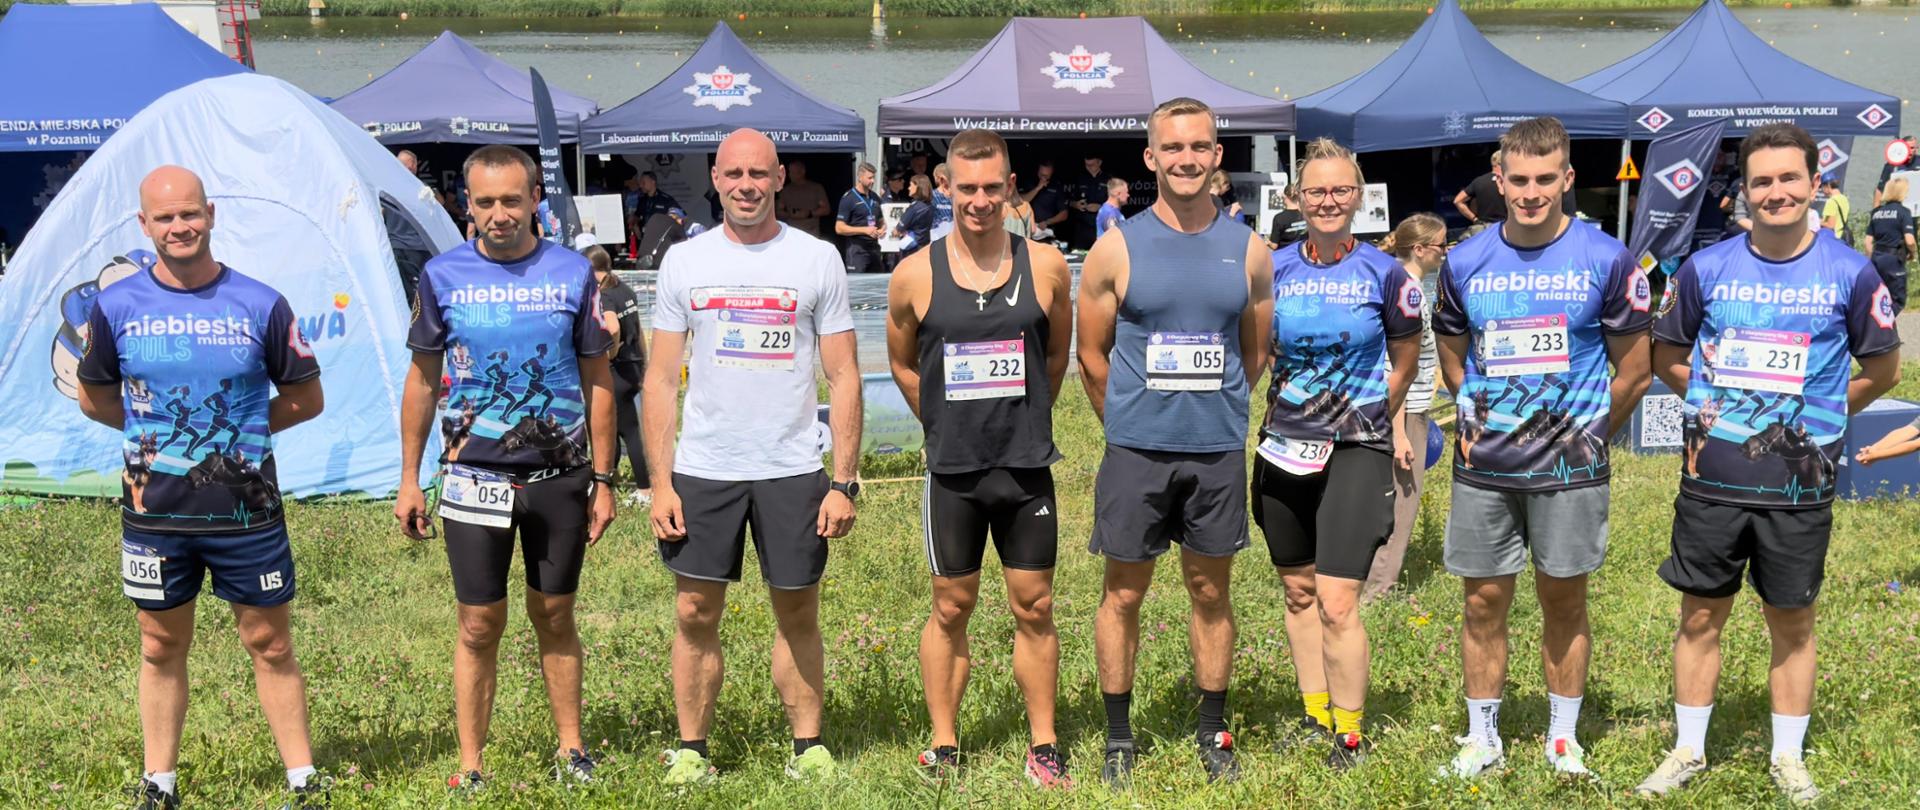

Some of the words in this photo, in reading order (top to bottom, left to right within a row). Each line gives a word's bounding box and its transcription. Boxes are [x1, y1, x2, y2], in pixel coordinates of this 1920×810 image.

[1688, 108, 1734, 117] KOMENDA
[1737, 105, 1801, 116] WOJEWÓDZKA
[1803, 107, 1838, 115] POLICJI
[41, 119, 100, 130] MIEJSKA
[384, 122, 422, 132] POLICJA
[472, 122, 509, 132] POLICJA
[954, 117, 1014, 130] Wydział
[1020, 117, 1093, 133] Prewencji
[1099, 118, 1137, 130] KWP
[1735, 119, 1742, 127] W
[26, 136, 37, 145] w
[41, 133, 101, 145] Poznaniu
[601, 132, 669, 144] Laboratorium
[803, 131, 848, 142] Poznaniu
[1872, 210, 1898, 219] POLICJA
[1279, 276, 1371, 298] niebieski
[1469, 269, 1591, 294] niebieski
[451, 283, 567, 304] niebieski
[1325, 296, 1369, 304] miasta
[1535, 292, 1588, 302] miasta
[1713, 280, 1836, 305] niebieski
[1468, 292, 1529, 320] PULS
[1781, 303, 1833, 316] miasta
[450, 303, 512, 328] PULS
[1711, 301, 1775, 329] PULS
[126, 313, 250, 337] niebieski
[197, 335, 250, 346] miasta
[761, 331, 791, 348] 229
[1531, 333, 1563, 351] 233
[125, 336, 192, 362] PULS
[990, 359, 1020, 376] 232
[1194, 351, 1221, 368] 055
[1766, 350, 1801, 370] 231
[1300, 442, 1328, 460] 230
[478, 486, 509, 505] 054
[130, 560, 158, 579] 056
[260, 571, 283, 591] US
